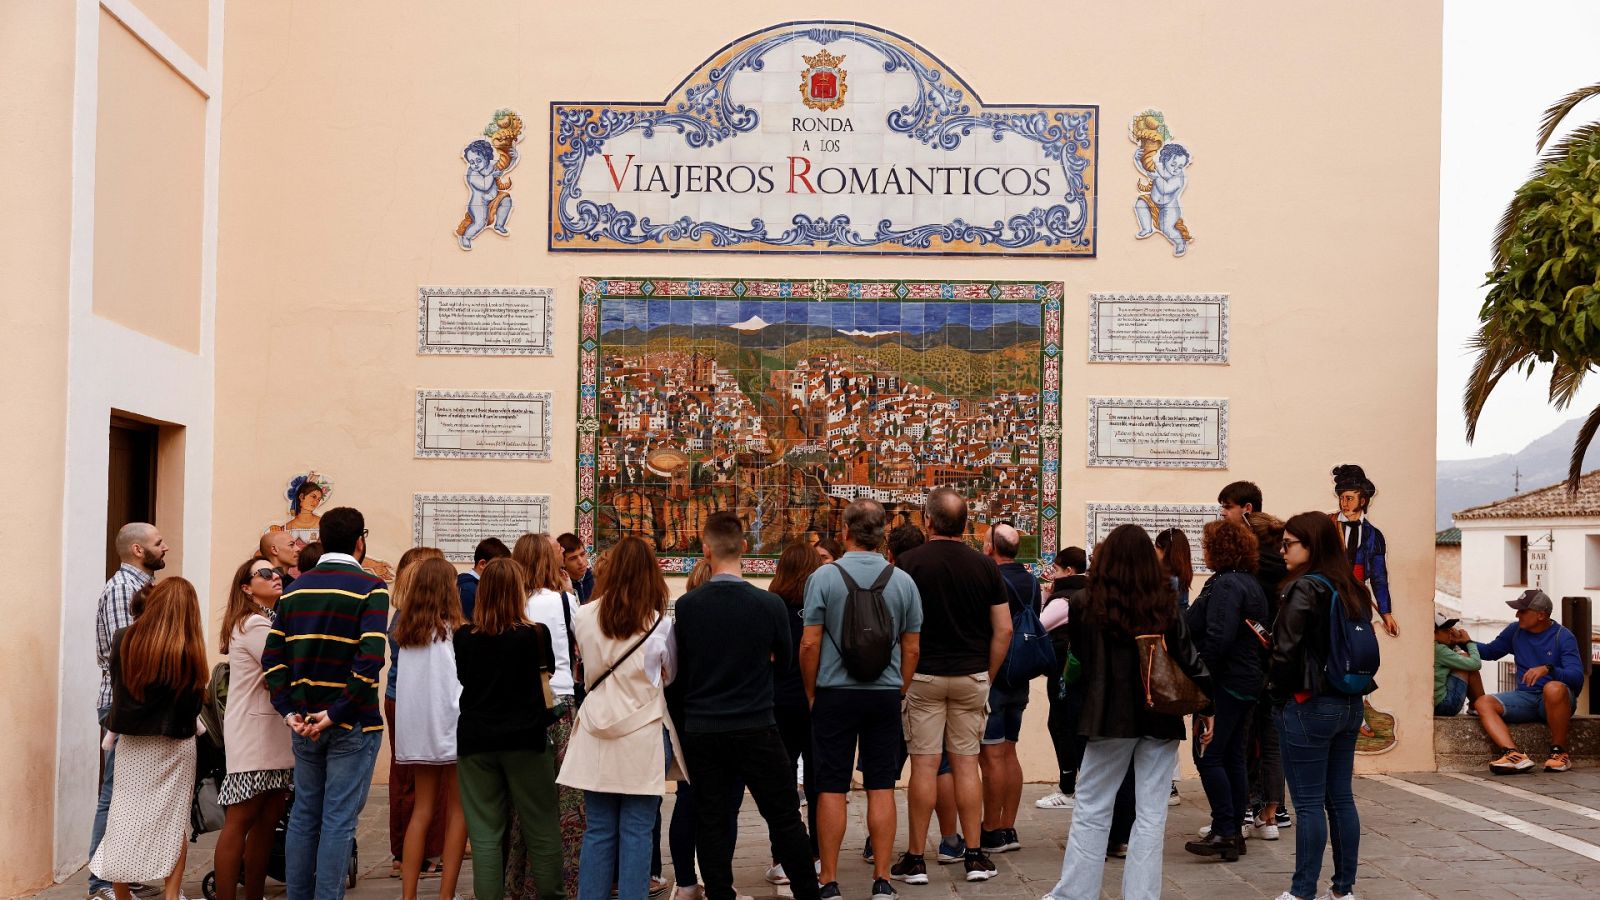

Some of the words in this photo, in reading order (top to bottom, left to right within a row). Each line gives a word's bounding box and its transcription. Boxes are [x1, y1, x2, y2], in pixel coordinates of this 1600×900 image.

[792, 117, 854, 132] RONDA
[802, 139, 810, 151] A
[820, 139, 840, 152] LOS
[602, 154, 775, 199] VIAJEROS
[785, 155, 1051, 196] ROMÁNTICOS
[1529, 562, 1548, 571] CAFÉ
